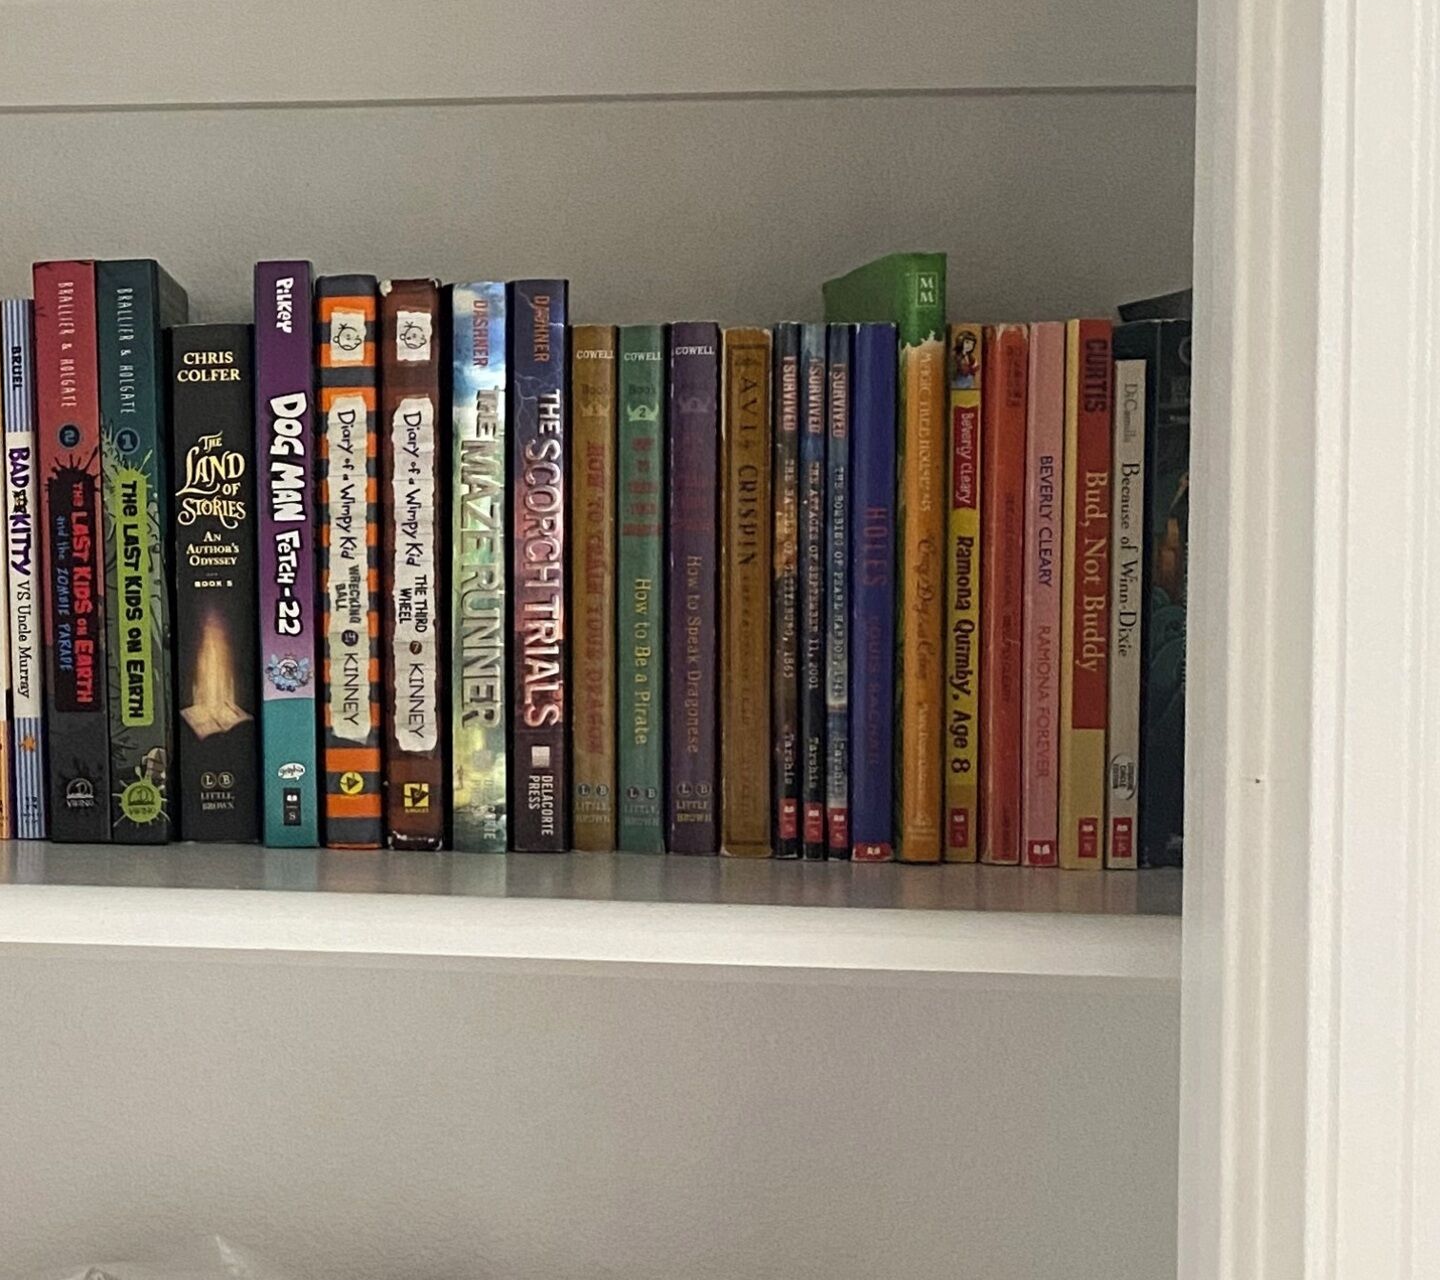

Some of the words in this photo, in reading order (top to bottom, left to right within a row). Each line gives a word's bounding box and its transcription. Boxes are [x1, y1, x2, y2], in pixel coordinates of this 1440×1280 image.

[58, 281, 74, 335] BRALLIER
[473, 299, 489, 367] DASHNER
[534, 295, 550, 363] DASHNER
[11, 346, 23, 391] BRUEL
[177, 368, 240, 382] COLFER
[183, 351, 233, 365] CHRIS
[624, 351, 662, 361] COWELL
[675, 346, 715, 355] COWELL
[60, 358, 77, 408] HOLGATE
[1084, 338, 1107, 414] CURTIS
[269, 392, 308, 457] DOG
[403, 411, 421, 459] Diary
[538, 388, 561, 434] THE
[175, 446, 245, 496] LAND
[270, 461, 306, 522] MAN
[411, 461, 420, 474] of
[1040, 455, 1053, 521] BEVERLY
[121, 480, 138, 517] THE
[178, 498, 246, 529] STORIES
[402, 488, 423, 538] Wimpy
[525, 439, 561, 587] SCORCH
[738, 464, 757, 565] CRISPIN
[1082, 472, 1108, 527] Bud,
[1120, 462, 1140, 530] Because
[123, 522, 141, 571] LAST
[189, 556, 237, 566] ODYSSEY
[405, 542, 423, 567] Kid
[1037, 526, 1053, 588] CLEARY
[1082, 536, 1107, 584] Not
[1120, 536, 1138, 552] of
[635, 578, 652, 615] How
[953, 536, 974, 610] Ramona
[124, 576, 143, 621] KIDS
[1117, 559, 1140, 657] Winn-Dixie
[127, 628, 141, 653] ON
[634, 622, 651, 639] to
[1075, 594, 1106, 671] Buddy
[524, 594, 559, 727] TRIALS
[634, 646, 652, 668] Be
[636, 673, 647, 683] a
[950, 620, 974, 700] Quimby,
[127, 659, 145, 719] EARTH
[343, 652, 359, 726] KINNEY
[409, 663, 424, 738] KINNEY
[635, 690, 652, 745] Pirate
[951, 711, 970, 749] Age
[951, 758, 970, 774] 8
[528, 775, 540, 810] PRESS
[541, 775, 553, 836] DELACORTE
